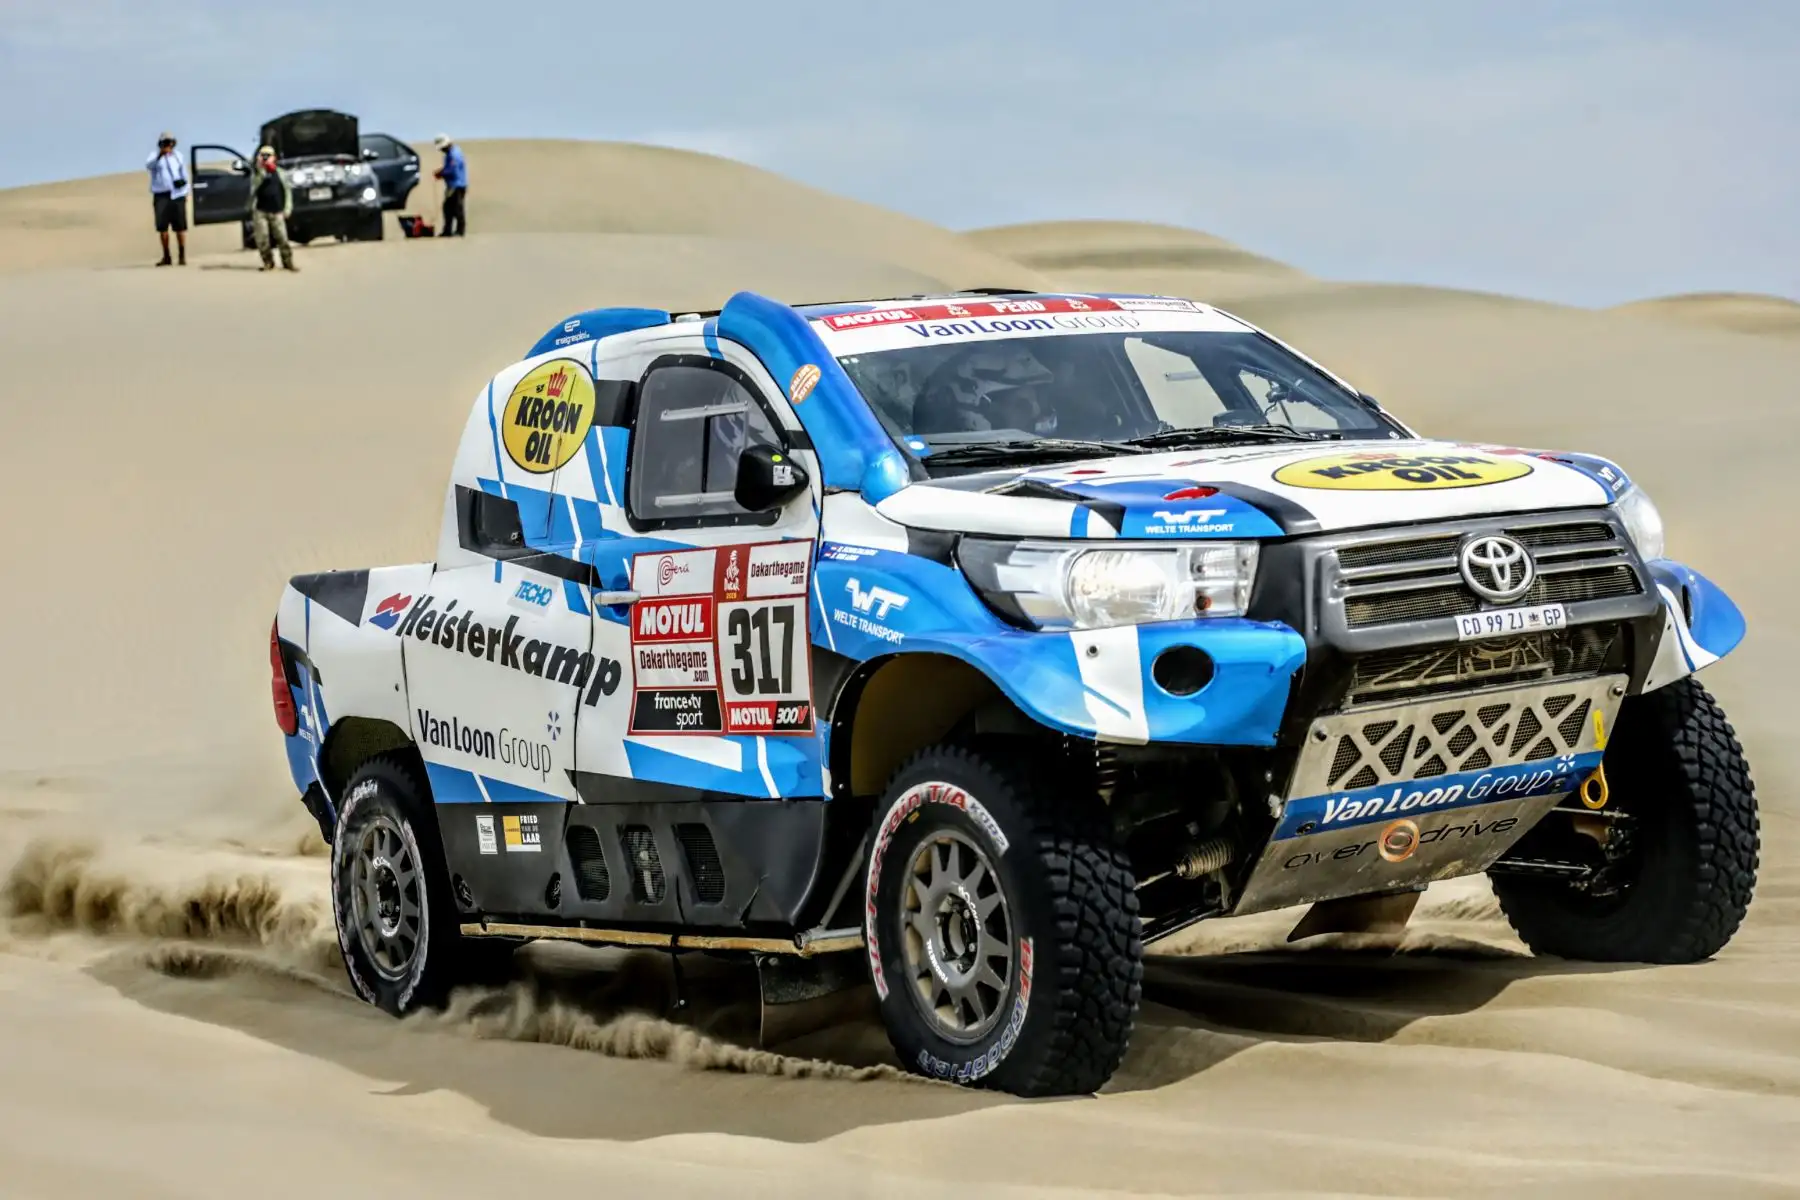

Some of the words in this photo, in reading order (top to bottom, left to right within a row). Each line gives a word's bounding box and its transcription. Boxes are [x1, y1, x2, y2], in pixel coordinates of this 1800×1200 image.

[833, 310, 913, 328] MOTUL
[904, 319, 1054, 338] VanLoon
[1053, 313, 1140, 330] Group
[515, 396, 583, 435] KROON
[525, 430, 553, 465] OIL
[1309, 455, 1498, 480] KROON
[1391, 465, 1483, 483] OIL
[1145, 525, 1177, 535] WELTE
[1179, 523, 1235, 534] TRANSPORT
[751, 560, 805, 578] Dakarthegame
[790, 575, 805, 585] .com
[639, 604, 705, 636] MOTUL
[833, 608, 858, 628] WELTE
[858, 618, 905, 646] TRANSPORT
[1462, 617, 1481, 636] CD
[1486, 615, 1503, 632] 99
[1508, 612, 1524, 630] ZJ
[1543, 608, 1561, 626] GP
[396, 594, 622, 707] Heisterkamp
[639, 650, 708, 672] Dakarthegame
[728, 605, 795, 696] 317
[692, 670, 709, 682] .com
[676, 711, 704, 731] sport
[730, 707, 773, 726] MOTUL
[775, 705, 809, 725] 300V
[417, 708, 496, 760] VanLoon
[498, 727, 552, 783] Group
[928, 785, 967, 812] T/A
[1322, 784, 1465, 824] VanLoon
[1466, 769, 1553, 801] Group
[520, 815, 538, 824] FRIED
[522, 833, 540, 843] LAAR
[1283, 838, 1379, 870] over
[1418, 816, 1520, 844] drive
